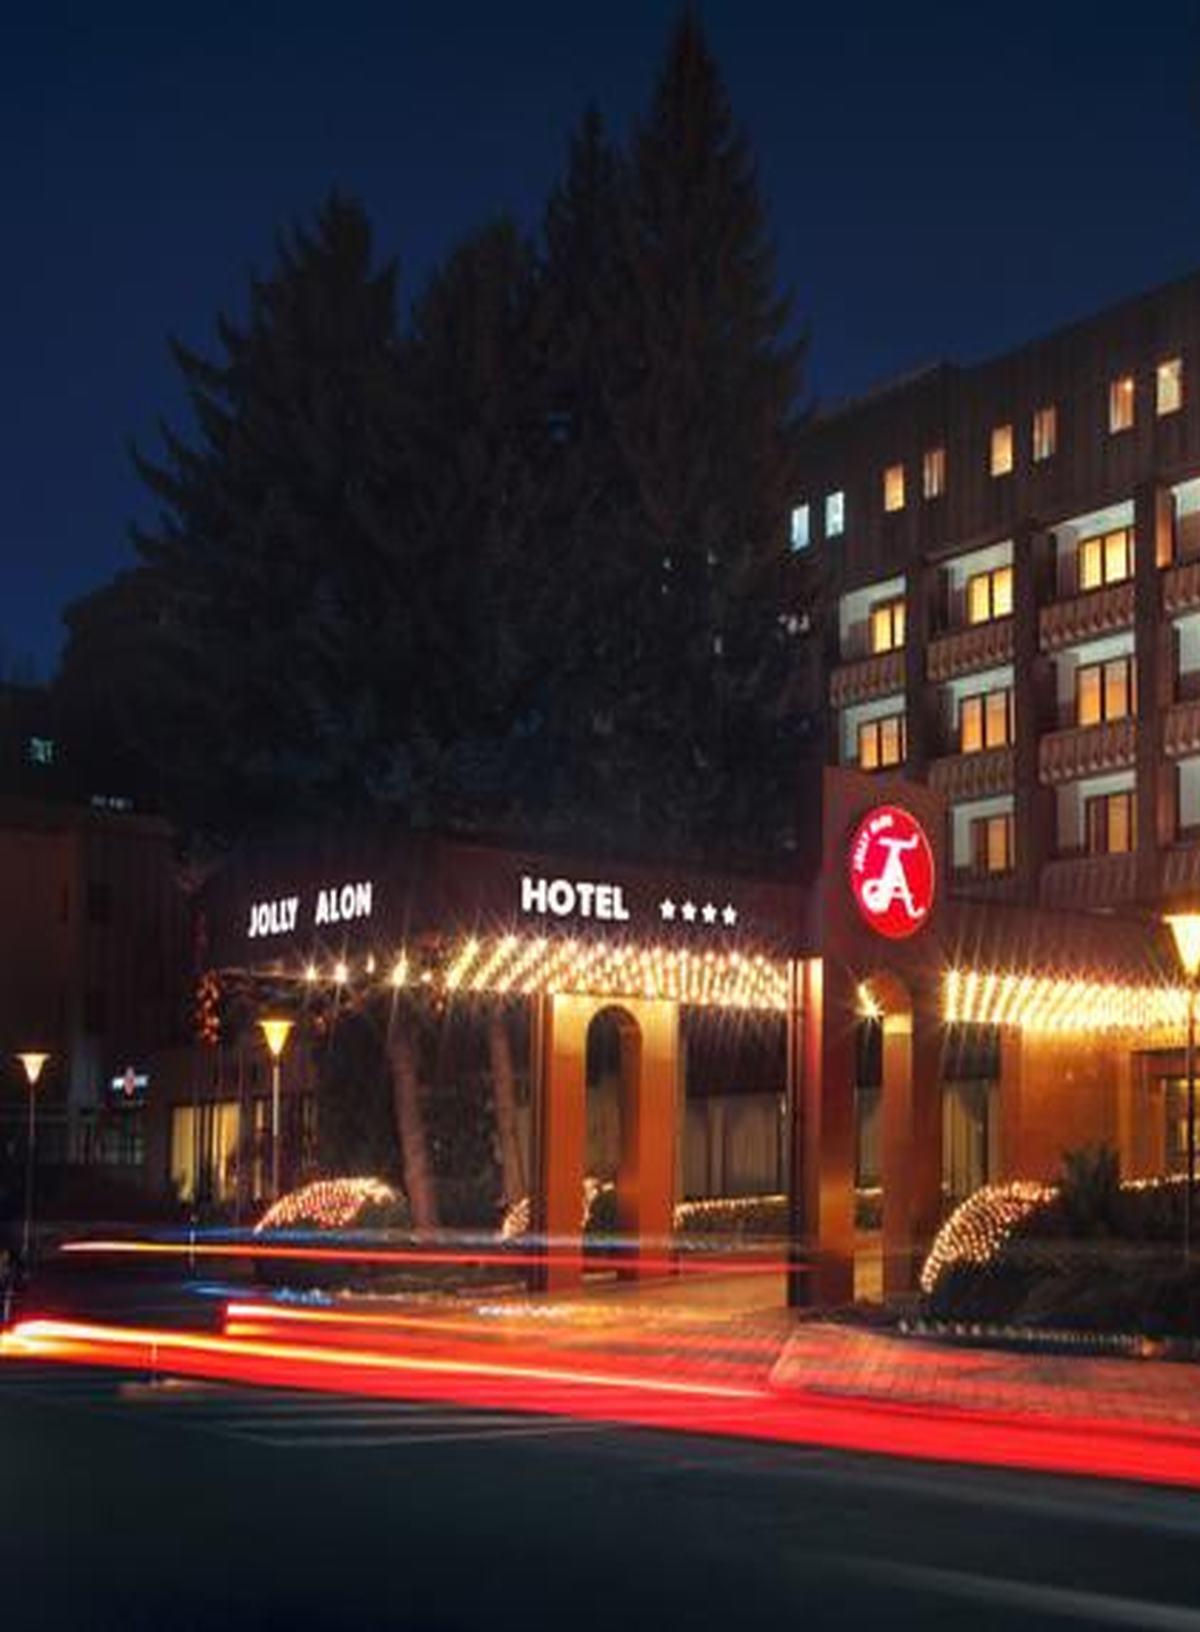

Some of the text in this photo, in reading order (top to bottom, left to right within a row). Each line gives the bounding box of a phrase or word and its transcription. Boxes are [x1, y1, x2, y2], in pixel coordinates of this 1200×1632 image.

[249, 881, 372, 938] JOLLY ALON
[521, 876, 629, 920] HOTEL
